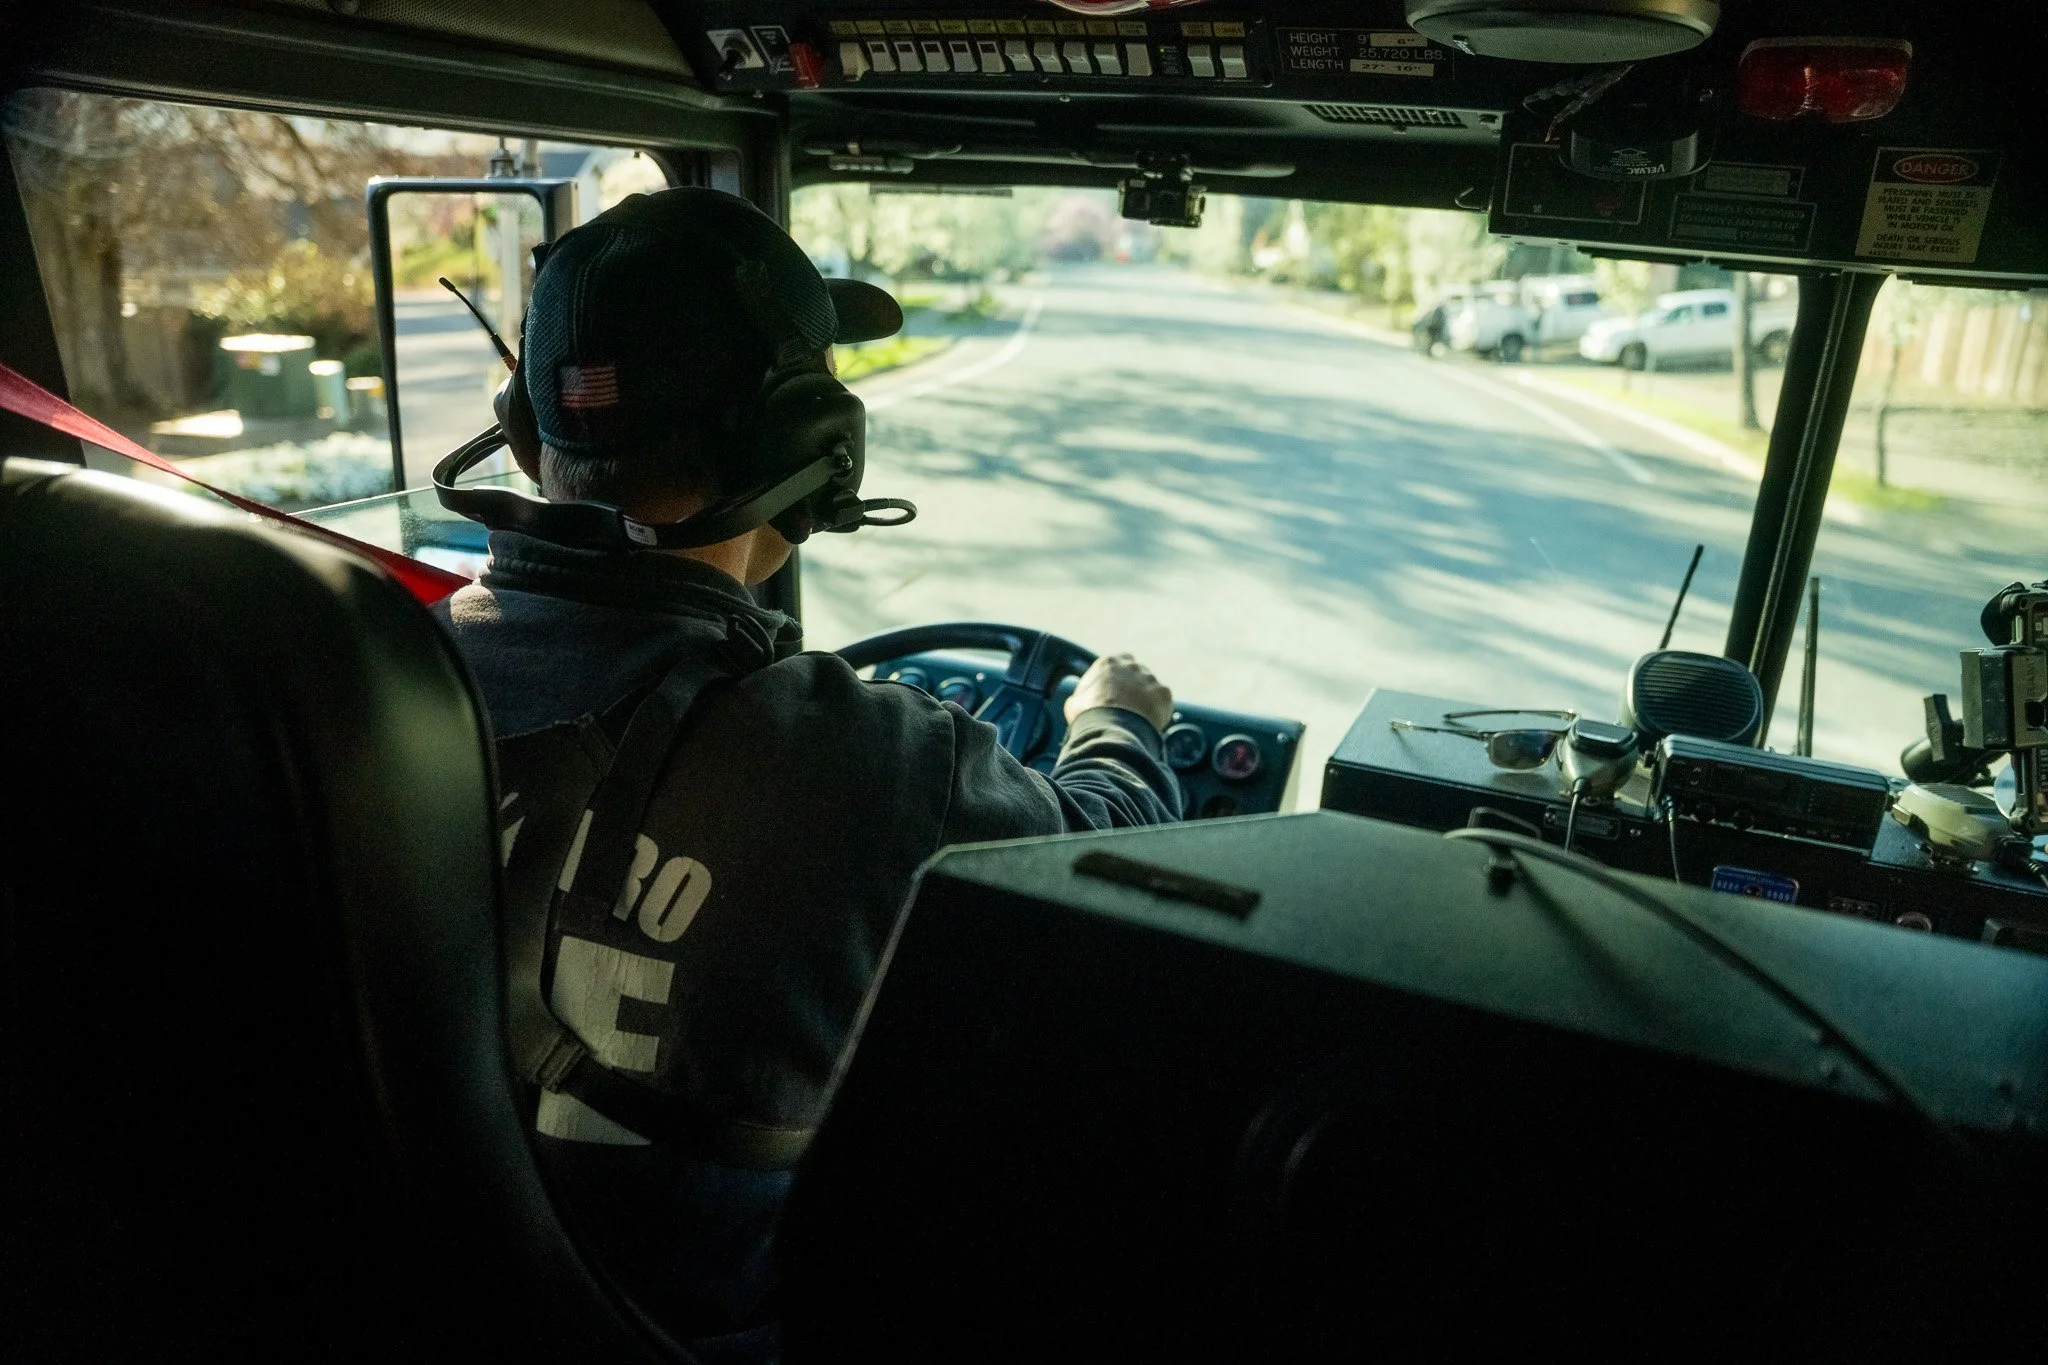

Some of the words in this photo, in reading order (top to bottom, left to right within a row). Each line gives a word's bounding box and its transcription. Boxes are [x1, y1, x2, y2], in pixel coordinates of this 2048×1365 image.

[1289, 32, 1337, 44] HEIGHT
[1290, 45, 1340, 58] WEIGHT
[1413, 50, 1447, 61] LBS.
[1291, 59, 1344, 70] LENGTH
[1626, 163, 1666, 175] VELVAC
[1901, 161, 1970, 176] DANGER
[1883, 188, 1933, 198] PERSONNEL
[1937, 190, 1961, 199] MUST
[1965, 191, 1977, 199] BE
[1878, 196, 1908, 205] SEATED
[1912, 197, 1932, 206] AND
[1883, 205, 1907, 213] MUST
[1924, 207, 1968, 216] FASTENED
[1886, 213, 1912, 222] WHILE
[1915, 214, 1950, 223] VEHICLE
[1953, 216, 1961, 225] IS
[1888, 221, 1898, 229] IN
[1900, 222, 1938, 231] MOTION
[1940, 224, 1955, 232] OR
[1876, 233, 1904, 242] DEATH
[1907, 235, 1921, 243] OR
[1924, 236, 1961, 246] SERIOUS
[1873, 241, 1903, 250] INJURY
[1907, 243, 1927, 252] MAY
[1929, 244, 1961, 254] RESULT
